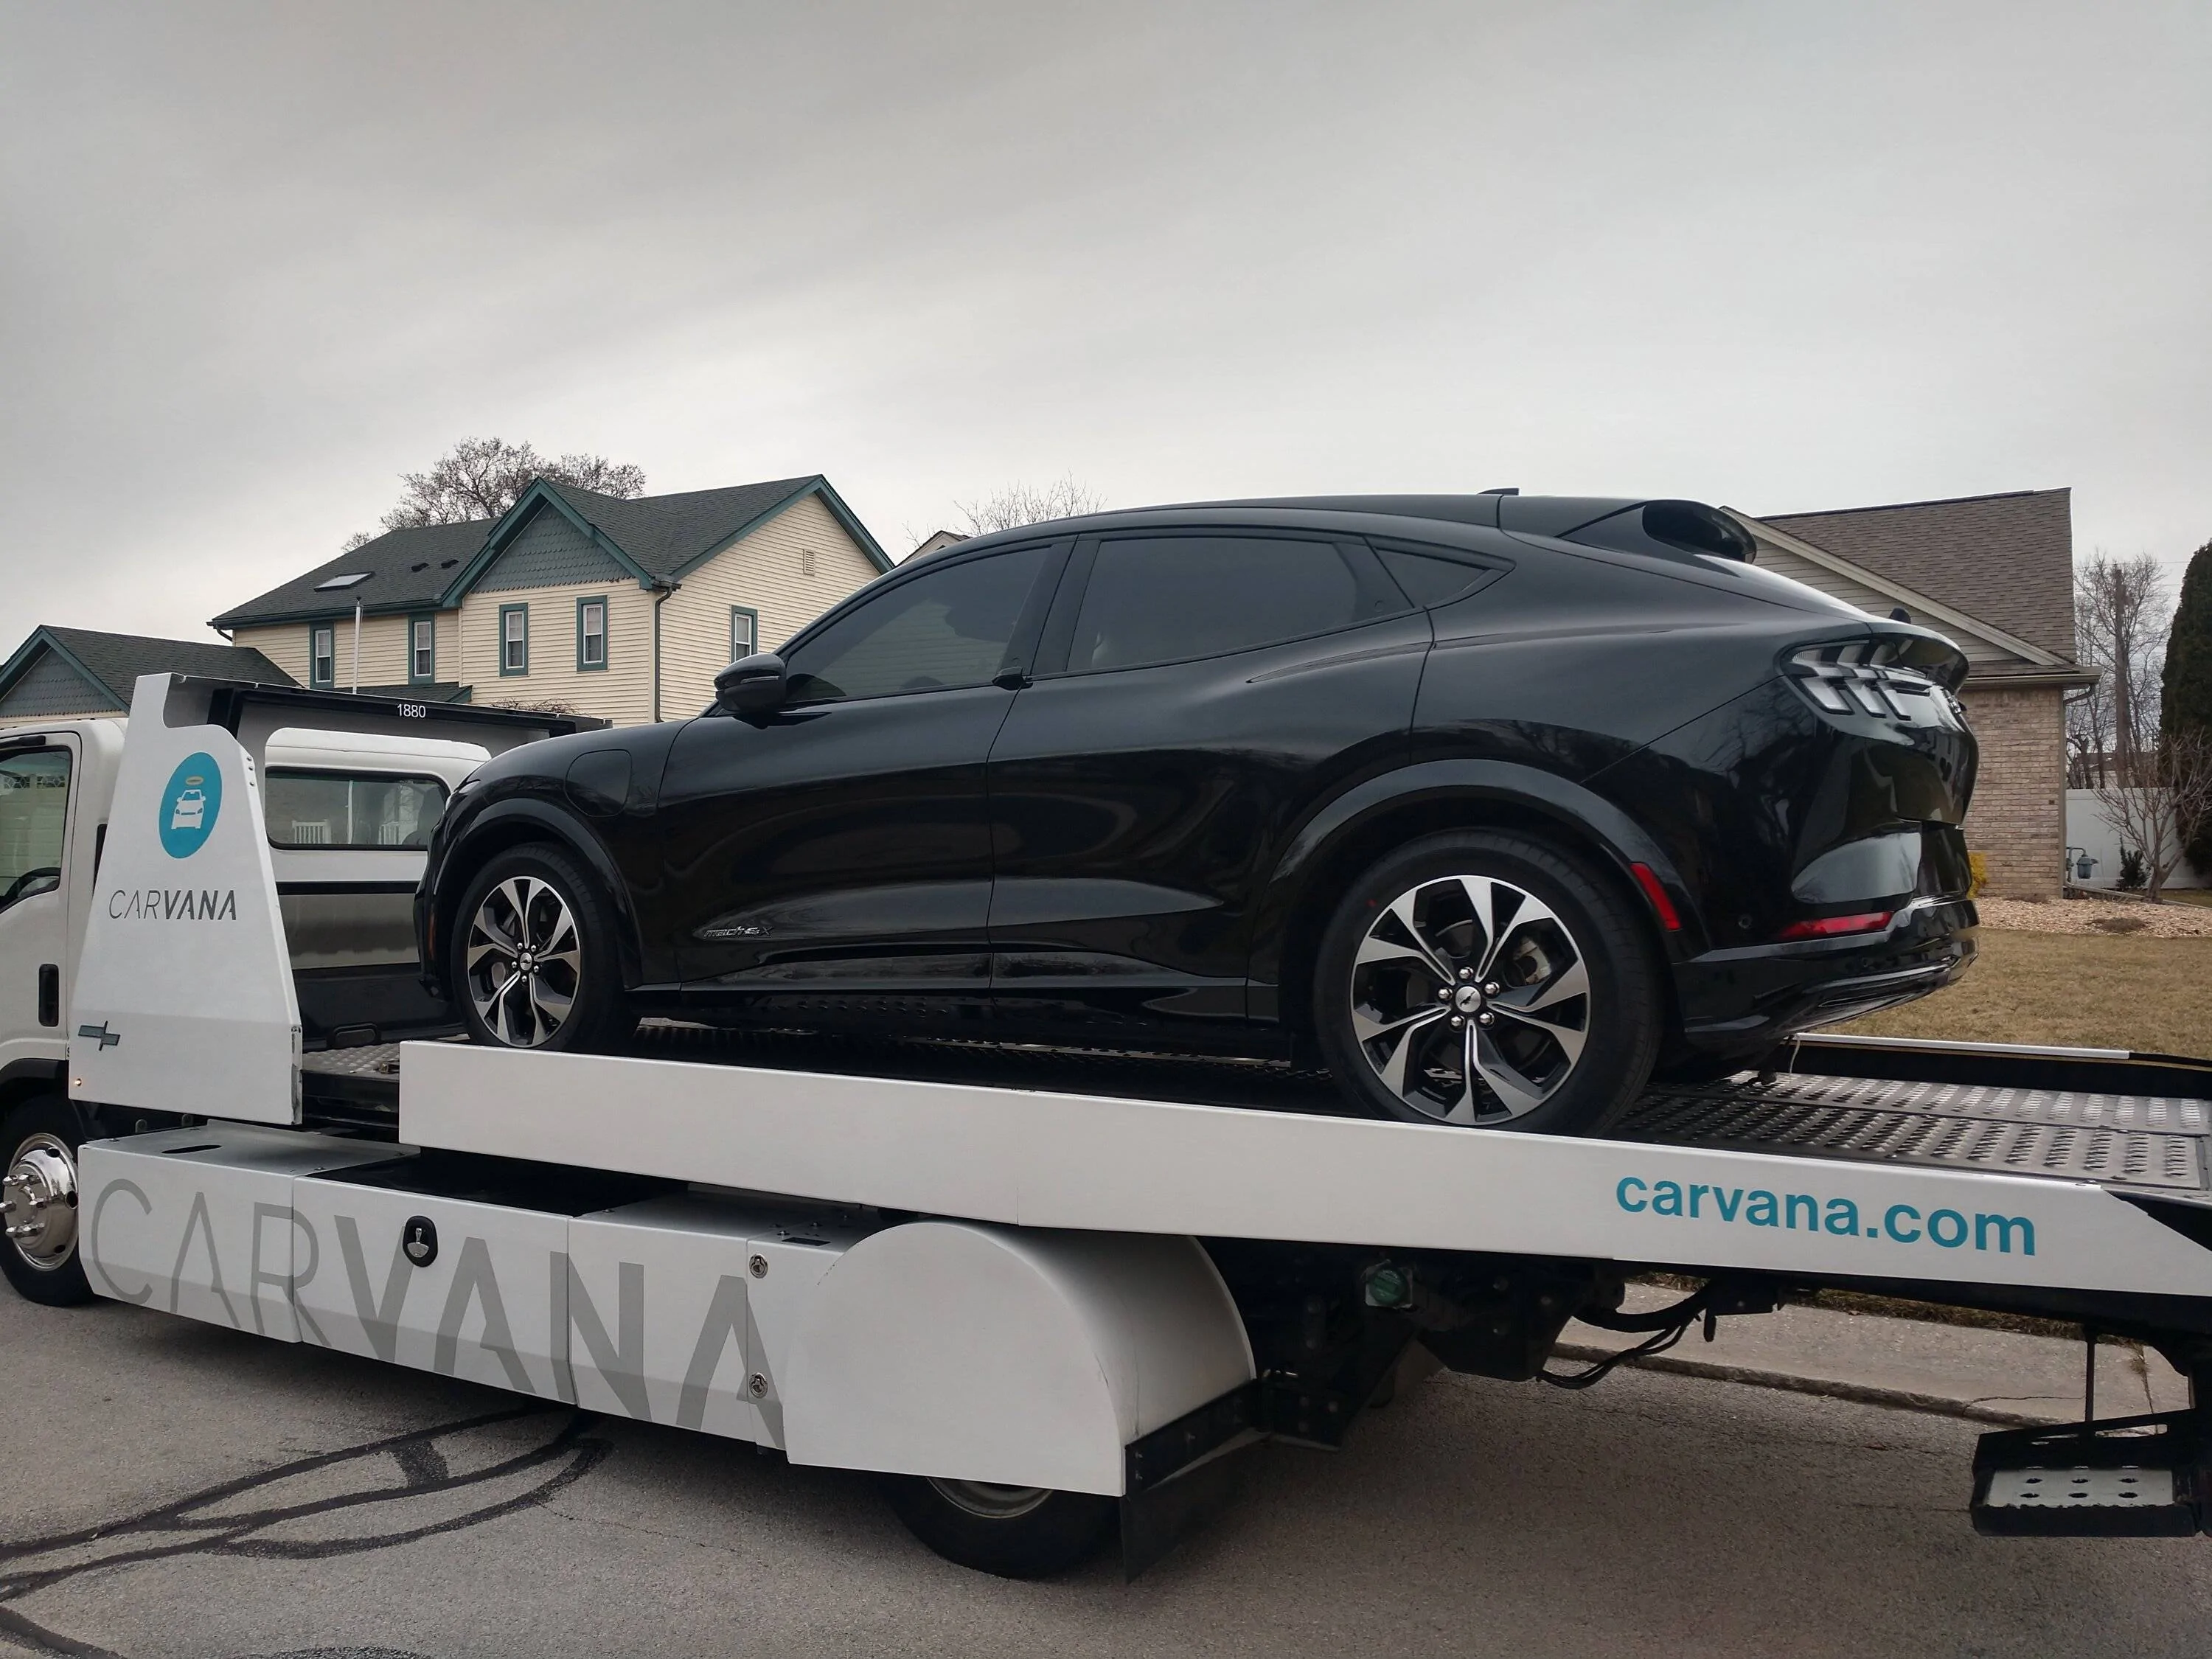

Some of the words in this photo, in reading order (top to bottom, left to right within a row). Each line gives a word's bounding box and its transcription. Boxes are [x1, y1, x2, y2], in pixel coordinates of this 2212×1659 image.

[397, 703, 426, 718] 1880
[108, 889, 237, 920] CARVANA
[1615, 1176, 2036, 1256] carvana.com
[91, 1178, 785, 1450] CARVANA
